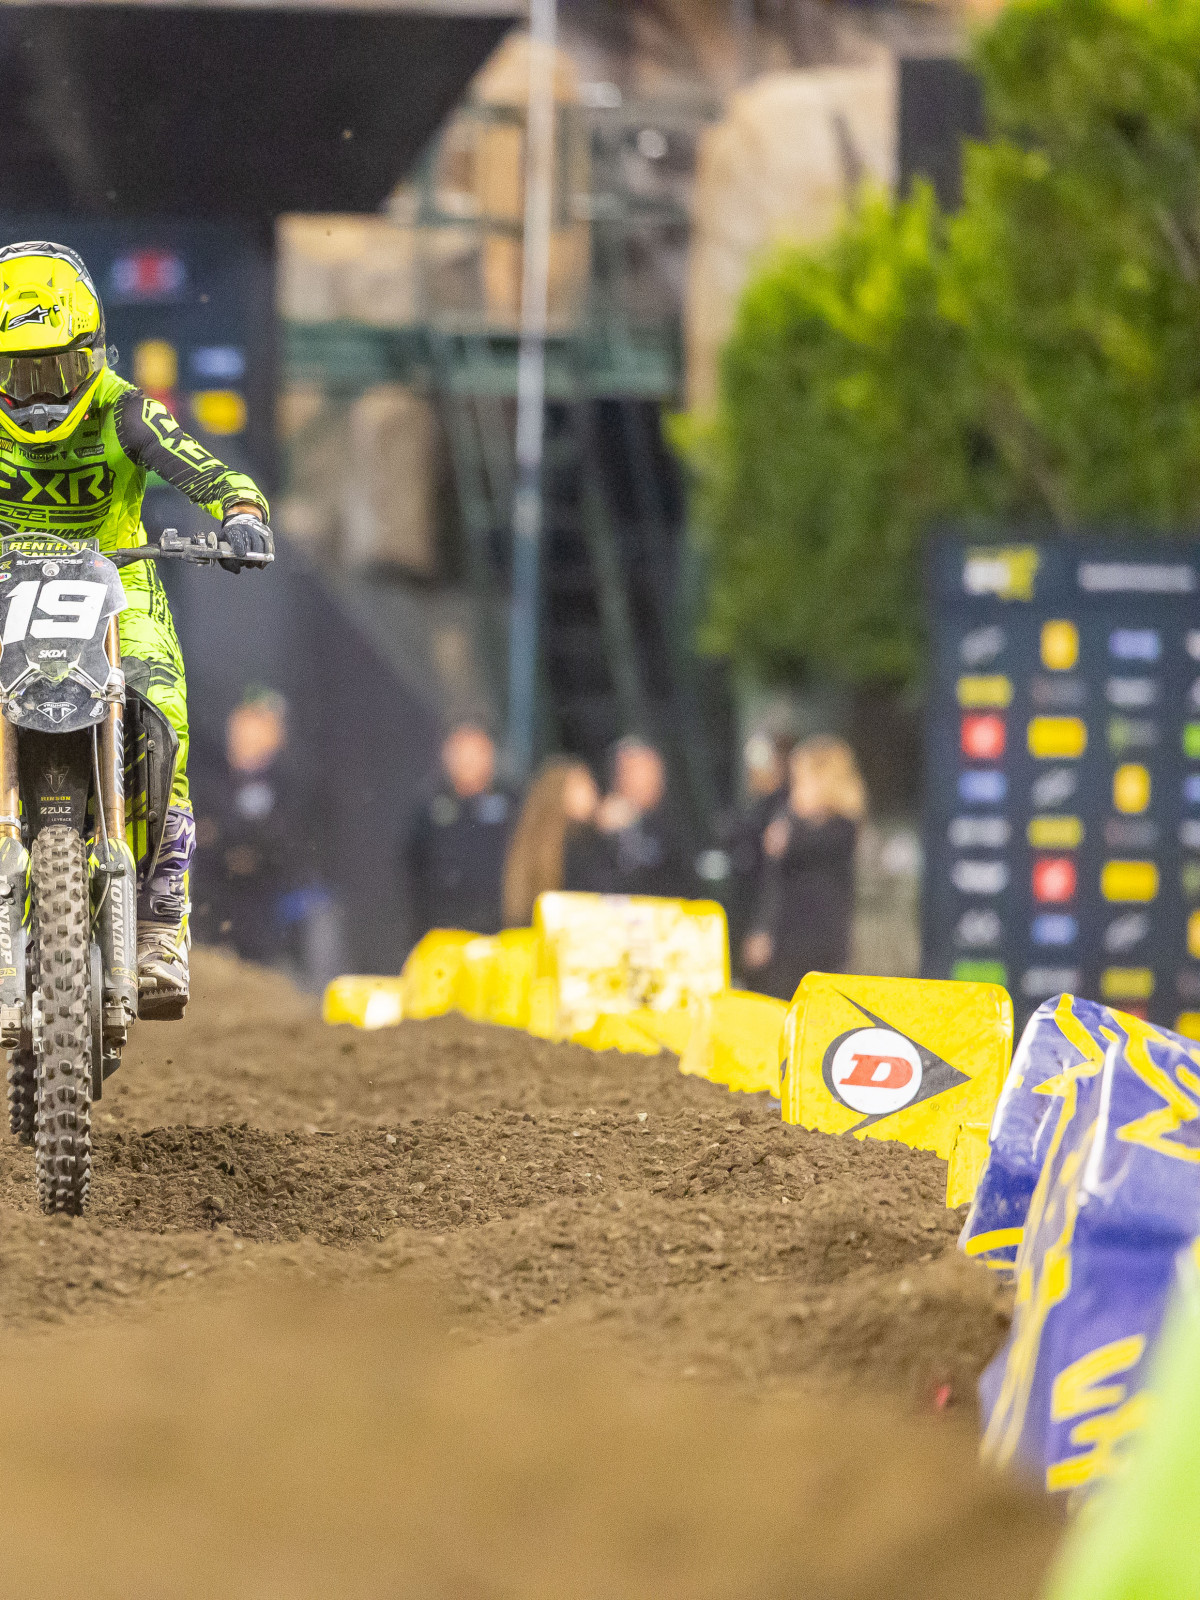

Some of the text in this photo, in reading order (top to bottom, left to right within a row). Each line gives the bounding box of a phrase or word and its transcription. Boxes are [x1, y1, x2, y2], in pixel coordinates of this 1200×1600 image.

[9, 541, 90, 551] RENTHAL
[16, 558, 83, 568] SUPERCROSS
[2, 579, 109, 646] 19
[38, 649, 67, 658] SKDA
[48, 806, 71, 814] ZULZ
[111, 878, 124, 964] DUNLO
[839, 1053, 914, 1090] D
